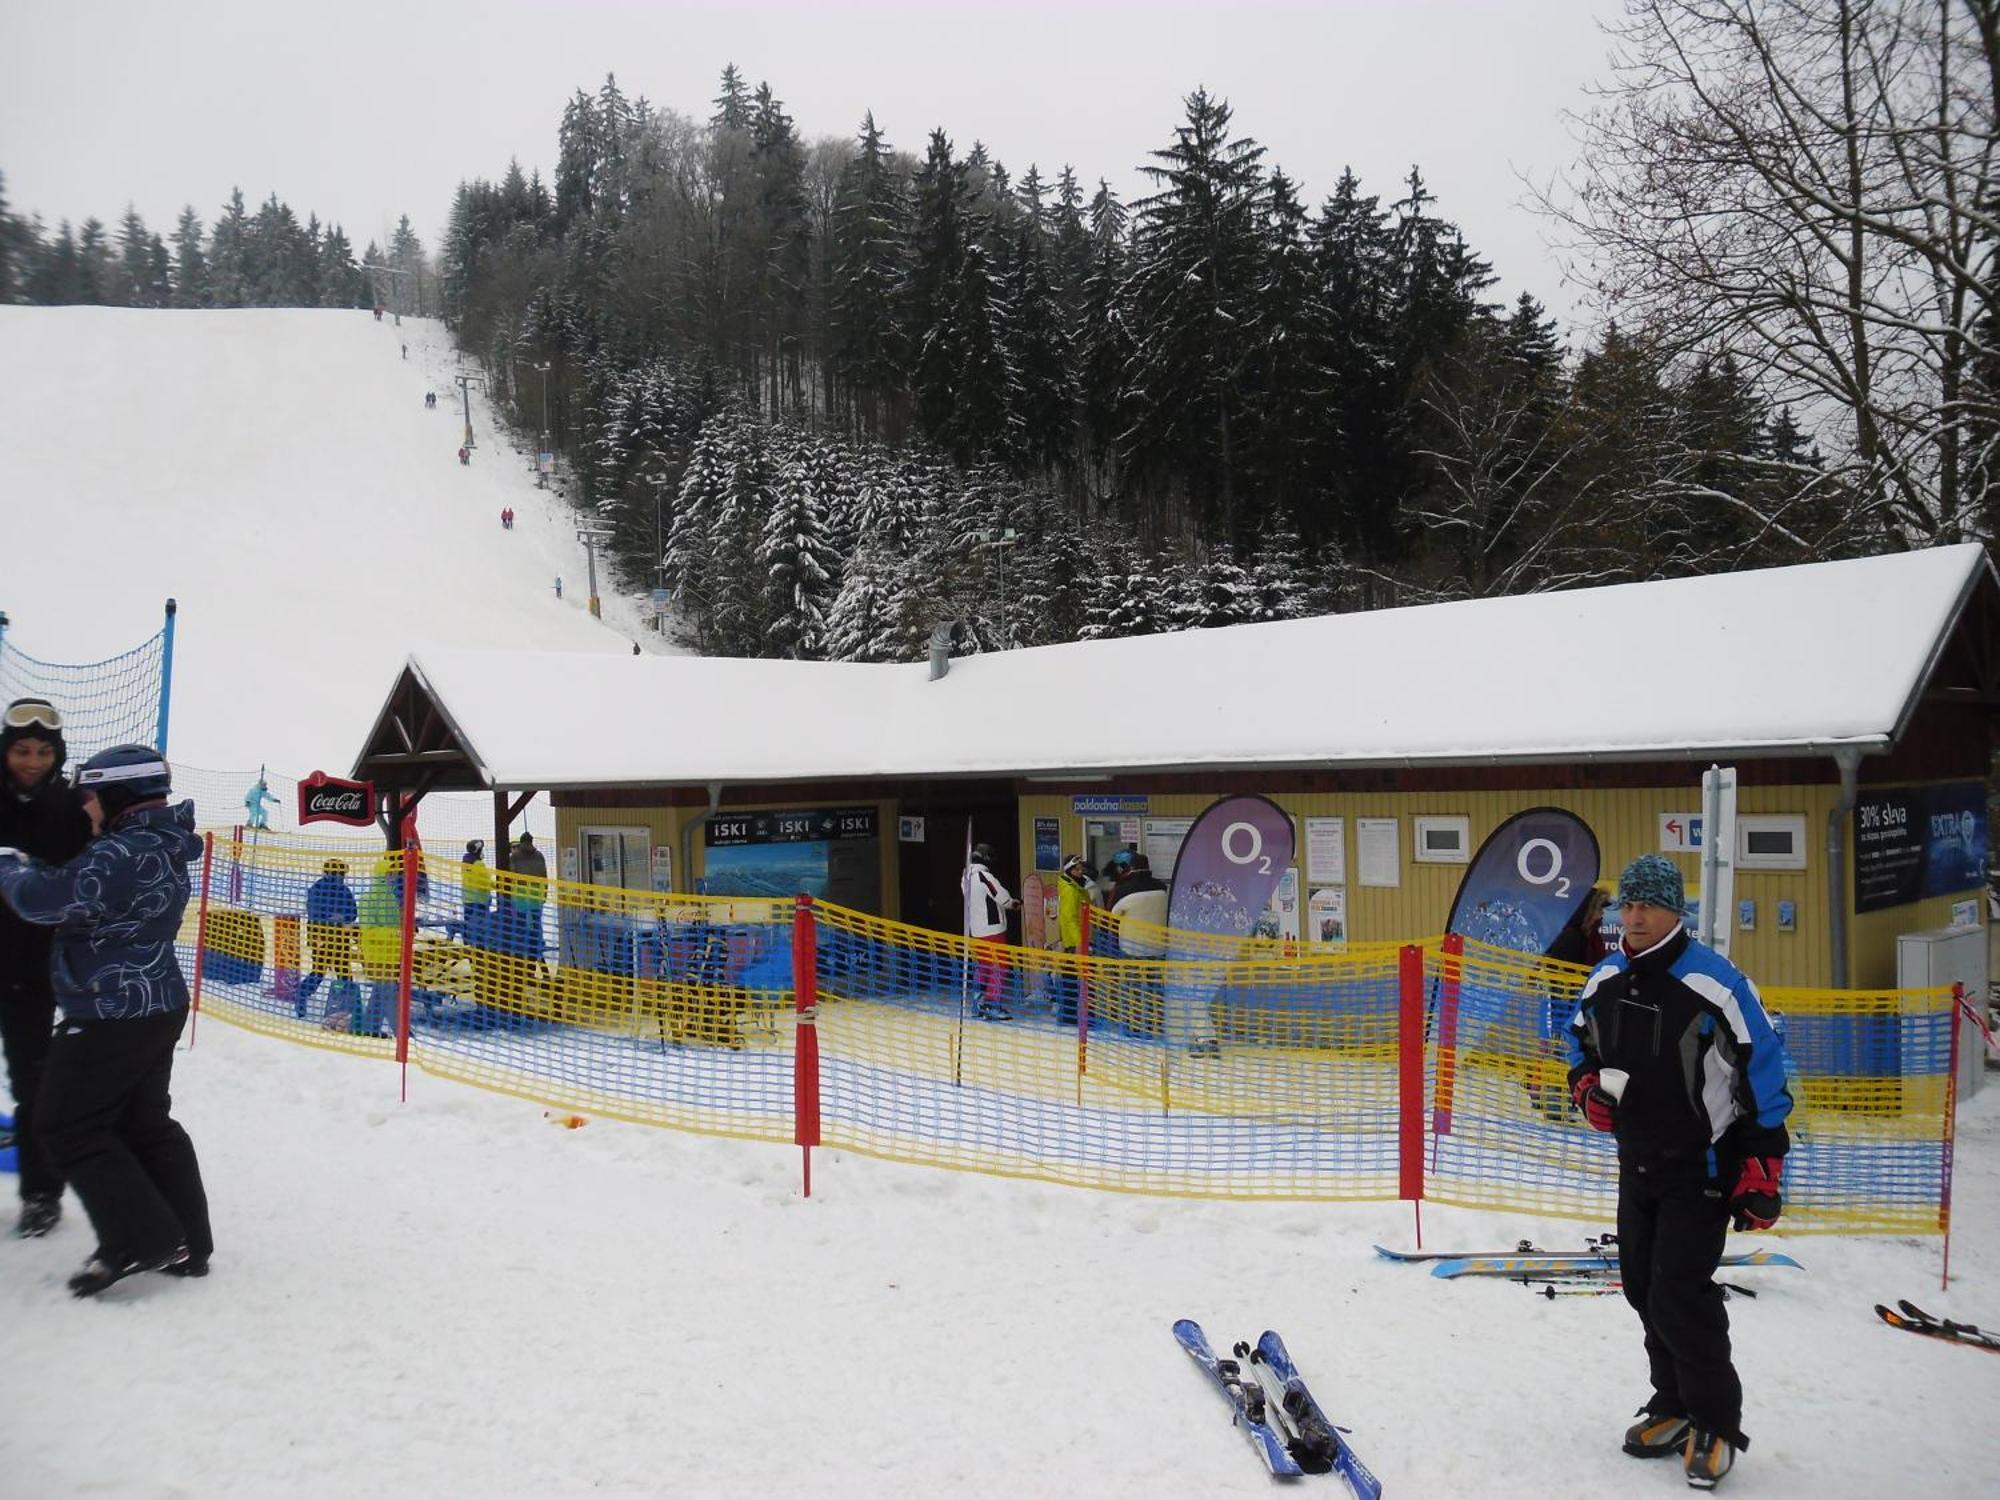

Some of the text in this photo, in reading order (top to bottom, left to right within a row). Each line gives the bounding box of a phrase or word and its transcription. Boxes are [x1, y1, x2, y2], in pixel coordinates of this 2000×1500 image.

[779, 820, 809, 833] iSKI
[1860, 803, 1906, 829] 30% sleva
[714, 823, 747, 837] iSKI
[1221, 822, 1272, 875] O2
[1517, 838, 1571, 898] O2
